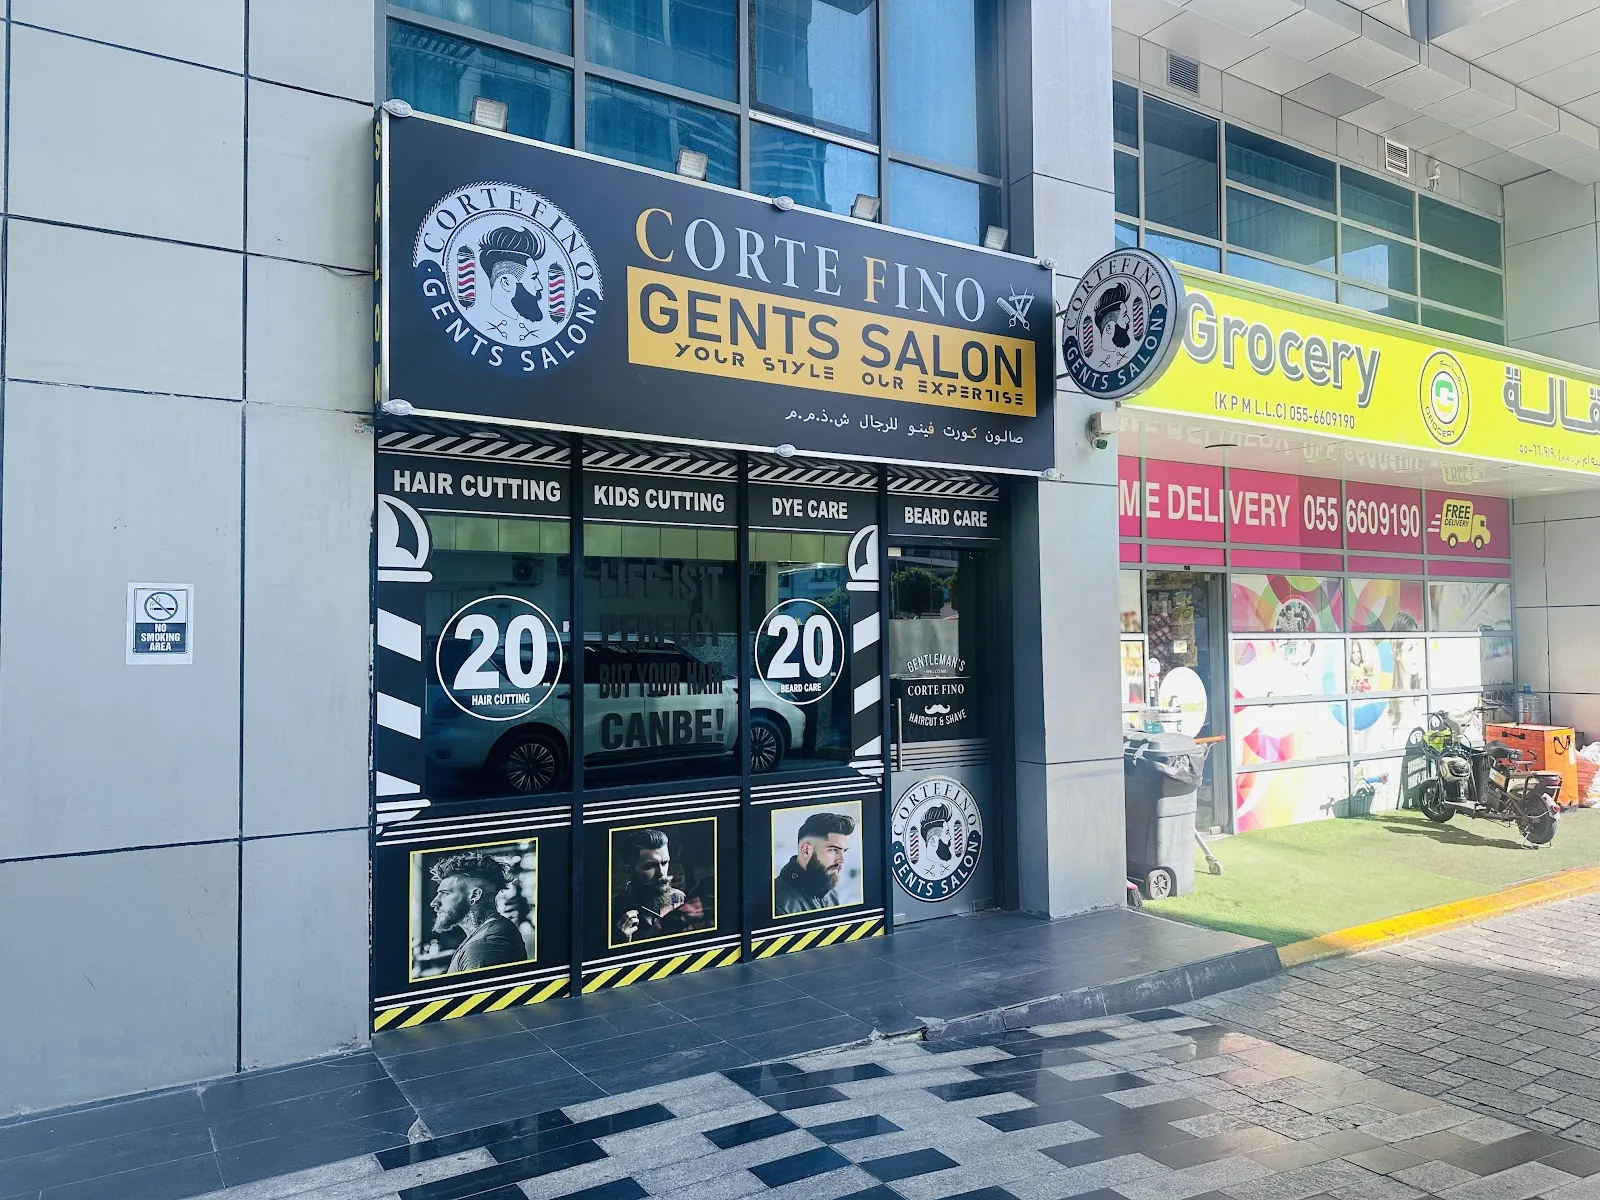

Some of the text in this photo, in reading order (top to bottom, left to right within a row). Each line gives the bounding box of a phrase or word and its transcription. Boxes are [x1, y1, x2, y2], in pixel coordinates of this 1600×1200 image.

[423, 188, 594, 280] CORTEFINO
[635, 207, 986, 322] CORTE FINO
[1067, 257, 1162, 330] CORTEFINO
[422, 278, 597, 371] GENTS SALON
[639, 282, 1023, 388] GENTS SALON
[1067, 318, 1164, 390] GENTS SALON
[1183, 291, 1381, 409] Grocery
[674, 342, 1023, 406] YOUR STYLE OUR EXPERTISE
[859, 414, 898, 433] للرجال
[1255, 399, 1287, 420] L.L.C)
[1290, 405, 1355, 429] 055-6609190
[907, 421, 935, 440] فينو
[943, 426, 978, 442] كورت
[985, 430, 1024, 445] صالون
[393, 469, 561, 502] HAIR CUTTING
[594, 485, 725, 513] KIDS CUTTING
[772, 497, 848, 520] DYE CARE
[904, 506, 988, 528] BEARD CARE
[1119, 479, 1420, 538] ME DELIVERY 055 6609190
[1444, 518, 1470, 528] DELIVERY
[1445, 503, 1471, 520] FREE
[599, 563, 661, 600] LIFE
[140, 632, 181, 642] SMOKING
[154, 623, 167, 632] NO
[600, 612, 720, 649] PERFECT
[149, 642, 172, 652] AREA
[453, 614, 548, 690] 20
[767, 614, 834, 679] 20
[907, 653, 966, 673] GENTLEMAN'S
[598, 661, 723, 699] BUT YOUR HAIR
[780, 683, 822, 694] BEARD CARE
[907, 683, 965, 696] CORTE FINO
[471, 693, 530, 706] HAIR CUTTING
[601, 709, 724, 750] CANBE!
[909, 708, 967, 727] HAIRCUT & SHAVE
[893, 782, 977, 836] CORTEFINO
[893, 841, 979, 896] GENTS SALON
